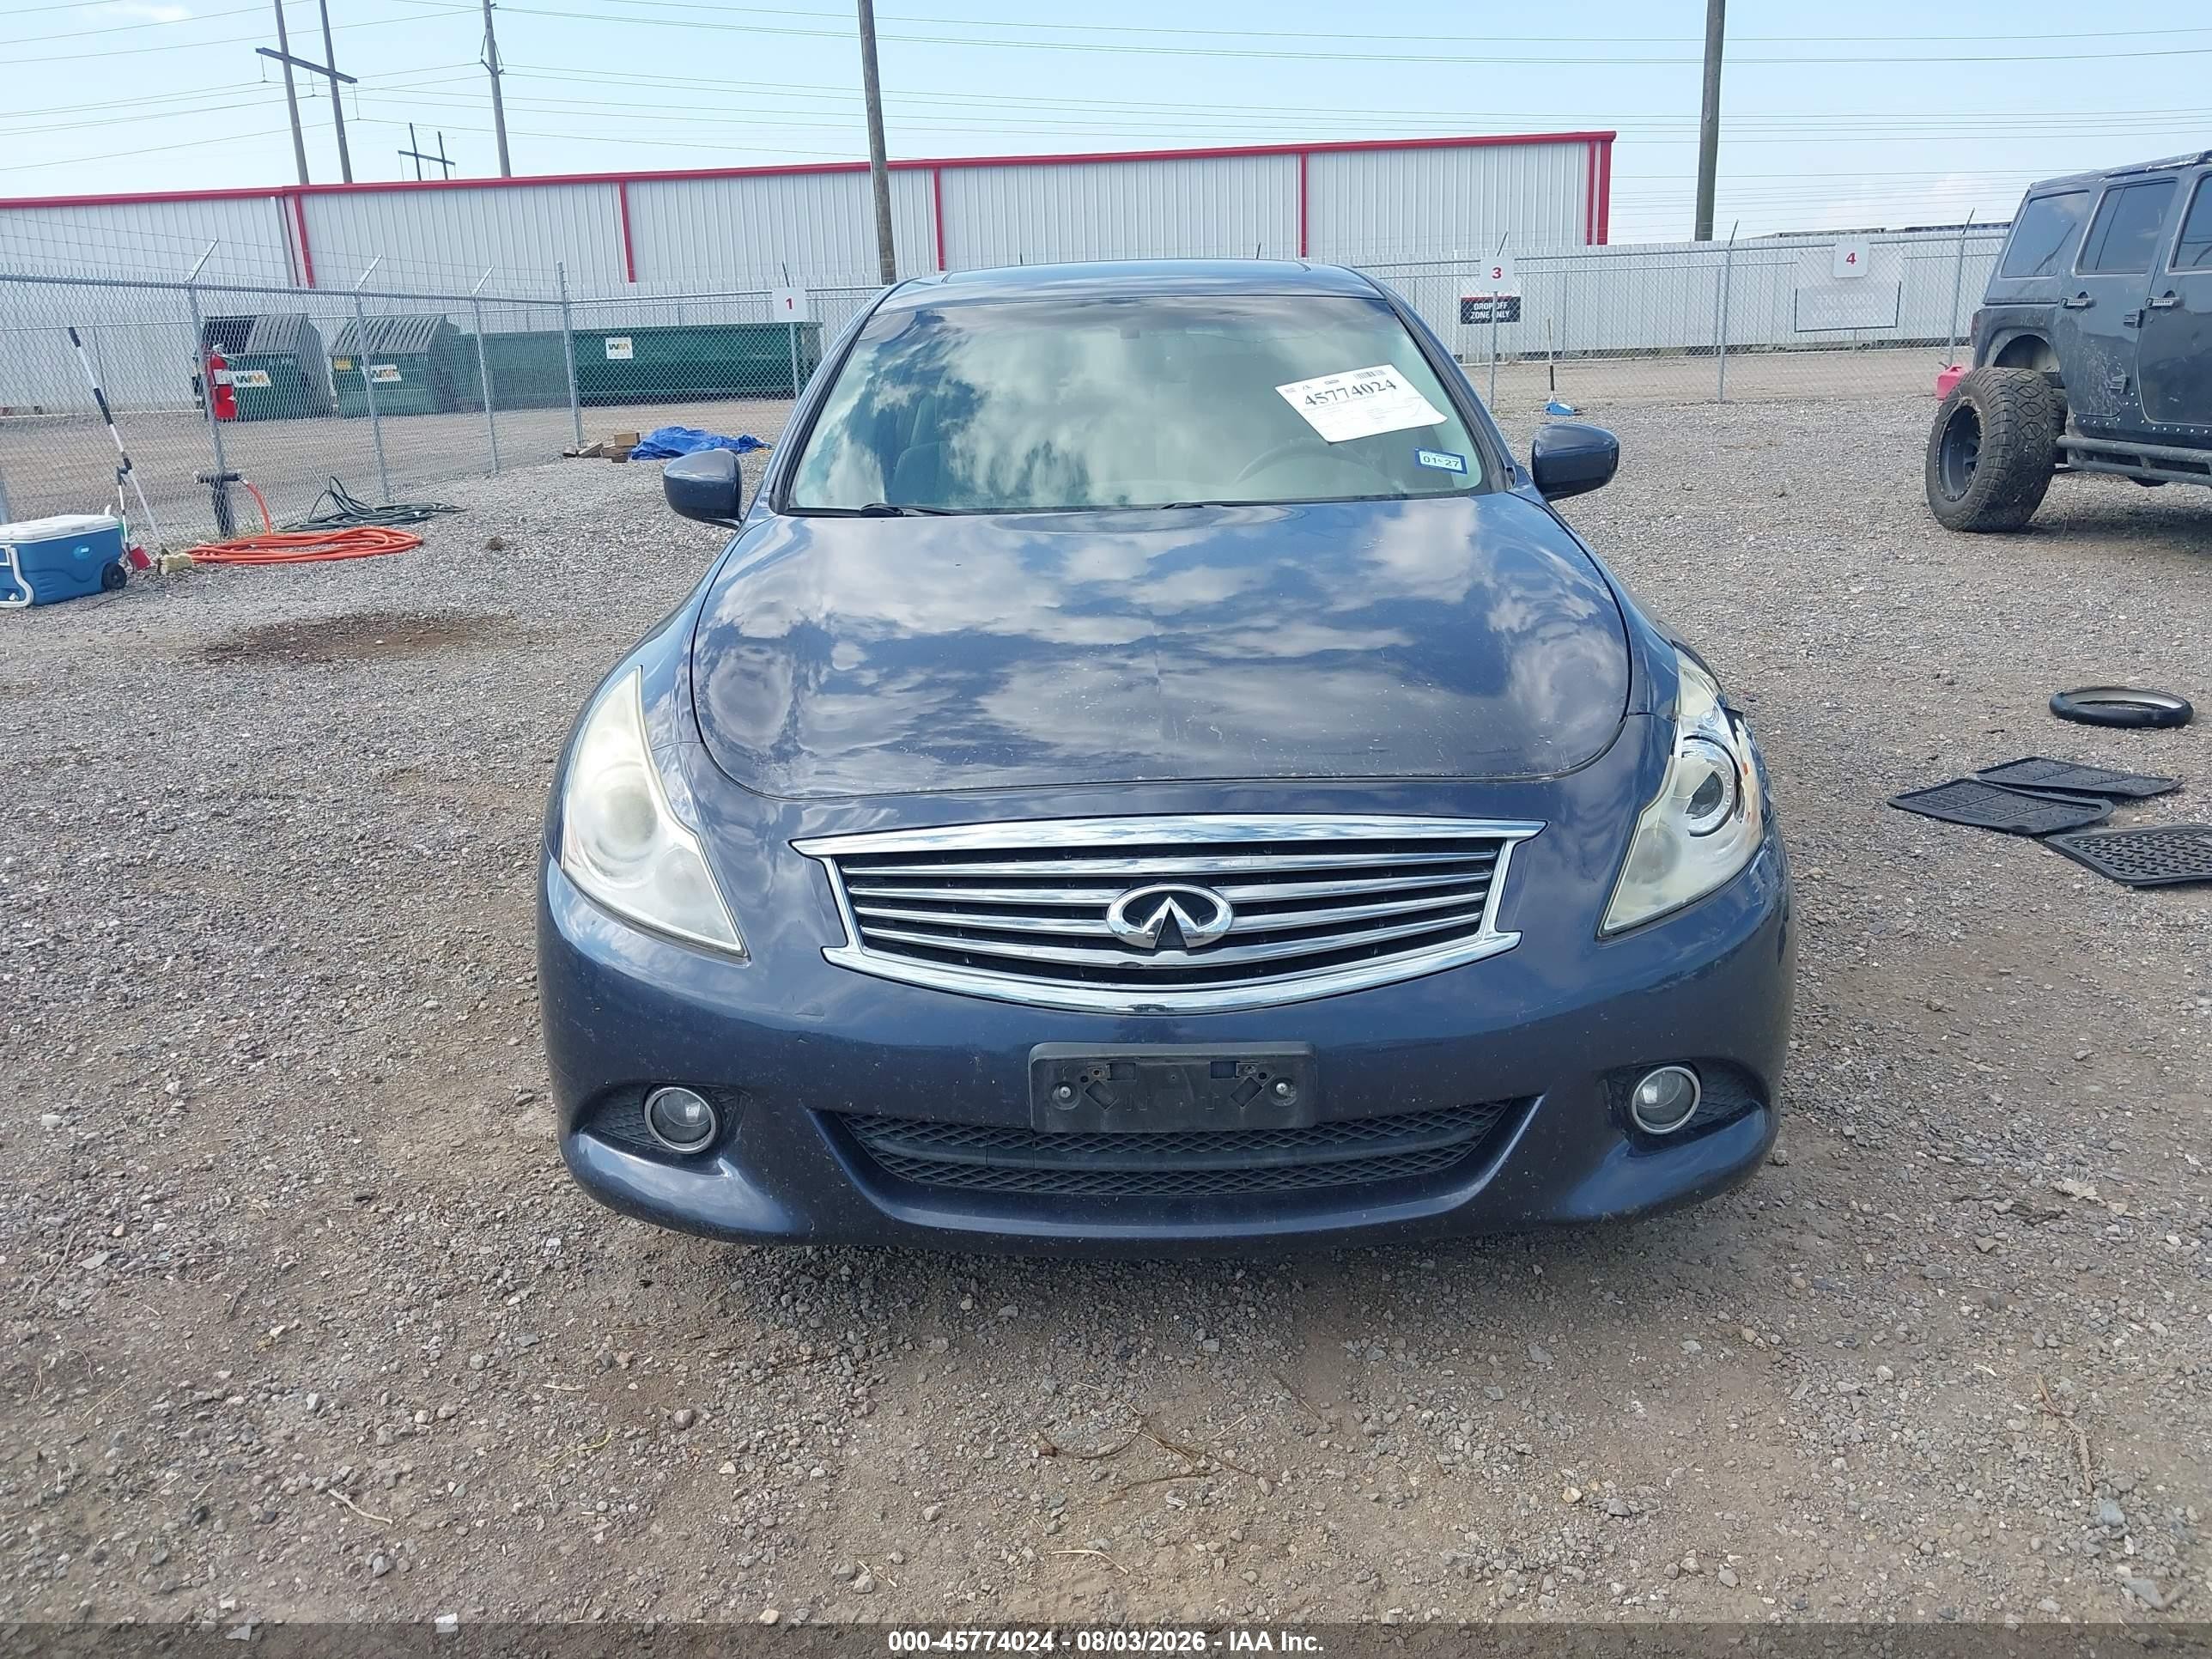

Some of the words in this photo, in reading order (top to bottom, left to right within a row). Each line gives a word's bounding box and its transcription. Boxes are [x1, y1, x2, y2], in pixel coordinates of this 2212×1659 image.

[1846, 252, 1856, 264] 4
[1492, 266, 1502, 279] 3
[786, 297, 793, 310] 1
[1474, 302, 1493, 311] DROP
[1470, 311, 1491, 319] ZONE
[1304, 379, 1397, 406] 45774024
